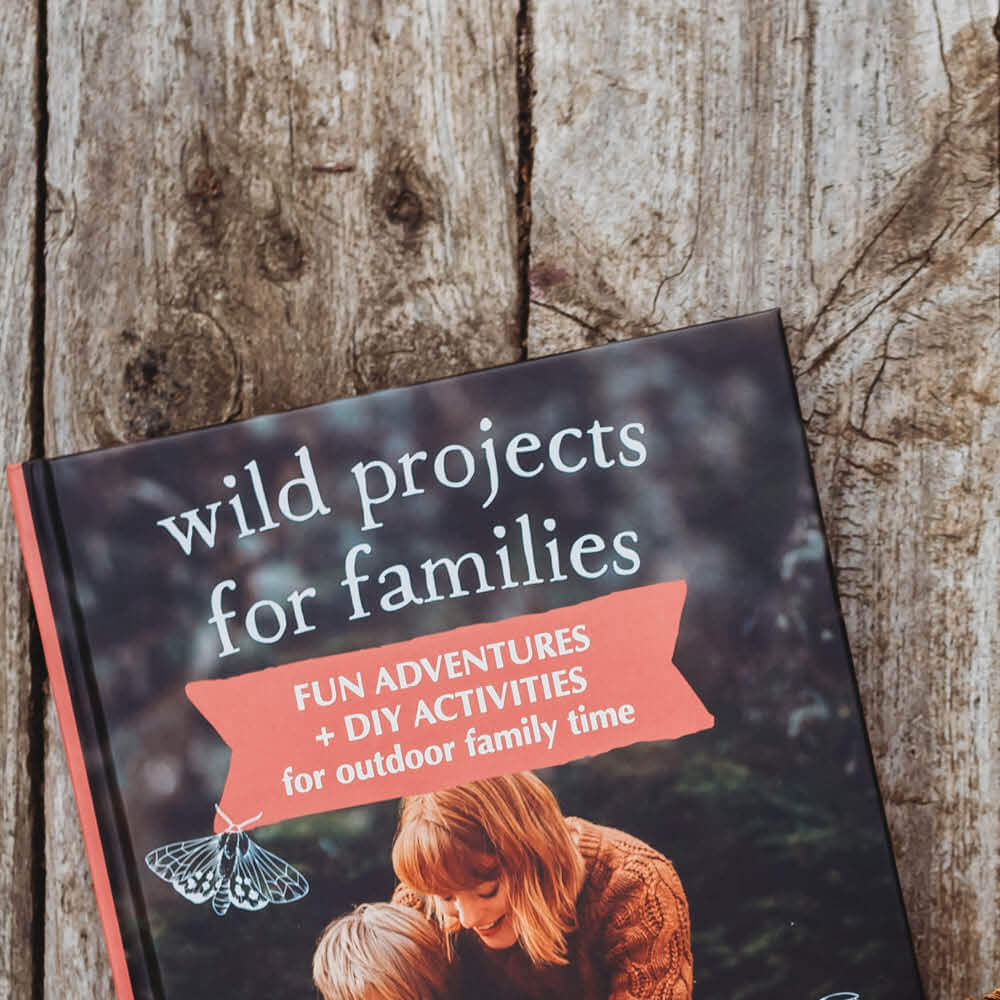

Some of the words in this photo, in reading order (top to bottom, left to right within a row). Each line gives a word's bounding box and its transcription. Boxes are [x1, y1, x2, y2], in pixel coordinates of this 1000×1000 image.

[156, 445, 332, 556] wild
[350, 417, 648, 531] projects
[206, 579, 317, 659] for
[340, 512, 642, 622] families
[293, 670, 364, 712] FUN
[374, 624, 592, 692] ADVENTURES
[314, 726, 336, 749] +
[345, 705, 401, 744] DIY
[413, 665, 588, 729] ACTIVITIES
[281, 760, 327, 797] for
[336, 737, 456, 785] outdoor
[464, 716, 558, 762] family
[568, 700, 636, 738] time
